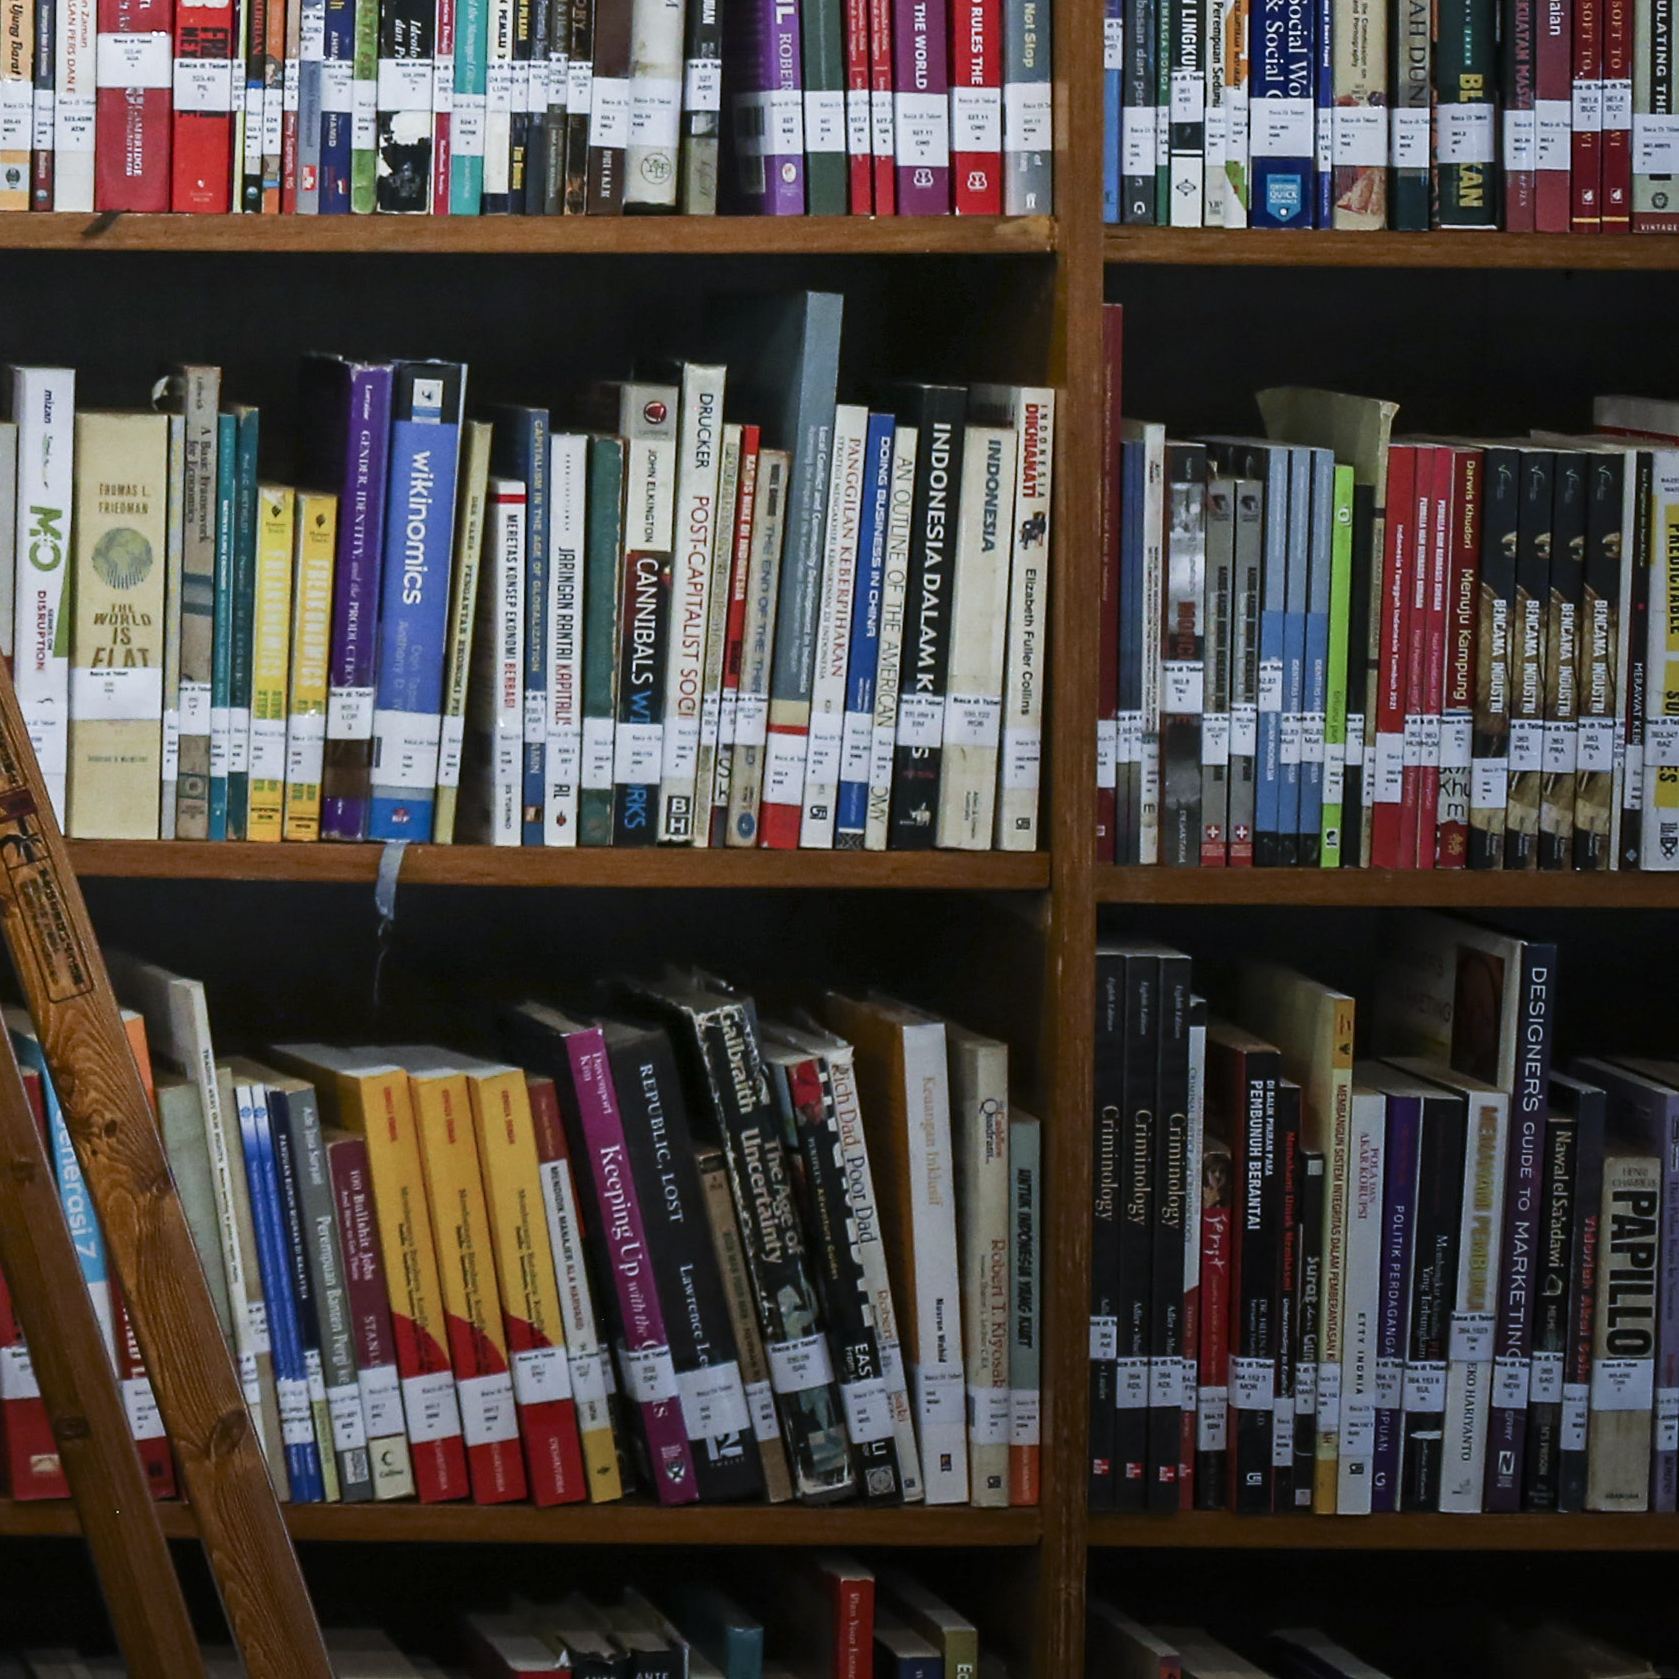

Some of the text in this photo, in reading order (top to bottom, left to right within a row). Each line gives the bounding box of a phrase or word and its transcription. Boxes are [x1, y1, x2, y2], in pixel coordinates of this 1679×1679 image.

[695, 394, 714, 468] DRUCKER
[403, 451, 432, 604] wikinomics
[632, 559, 657, 684] CANNIBALS
[1590, 600, 1607, 713] BENCANA INDUSTRI
[599, 1144, 641, 1276] Keeping Up
[1128, 1110, 1150, 1225] Criminology
[1247, 1081, 1263, 1229] PEMBUNUH BERANTAI
